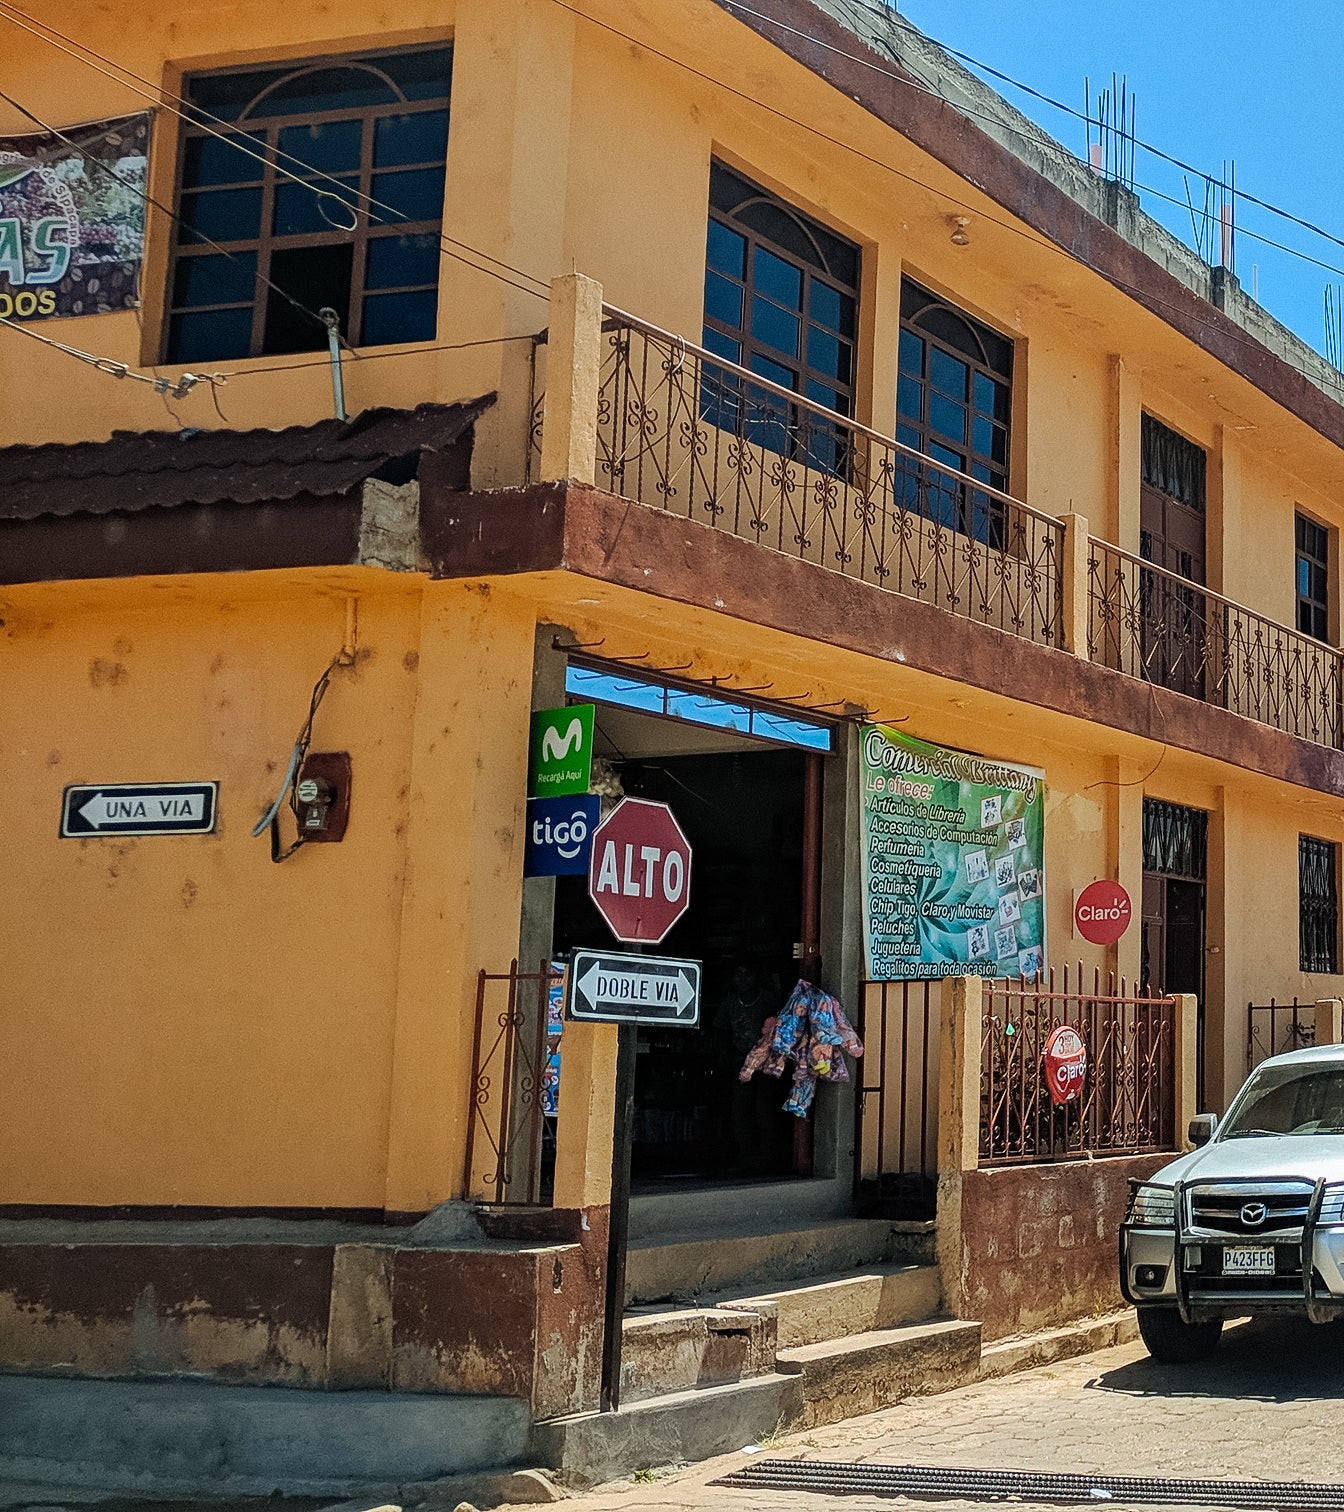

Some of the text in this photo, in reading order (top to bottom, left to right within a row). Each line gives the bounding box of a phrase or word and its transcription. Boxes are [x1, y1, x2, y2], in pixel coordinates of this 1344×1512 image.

[864, 728, 963, 782] Comercial
[566, 768, 582, 782] Aquí
[866, 769, 935, 800] Le ofrece:
[106, 799, 193, 818] UNA VIA
[870, 795, 966, 824] Artículos de Librería
[870, 815, 999, 847] Accesorios de Computación
[596, 840, 684, 903] ALTO
[870, 876, 917, 896] Celulares
[870, 896, 994, 921] Chip Tigo, Claro y Movistar
[1078, 900, 1124, 922] Claro
[870, 917, 916, 935] Peluches
[872, 957, 997, 979] Regalitos para toda ocasión
[596, 974, 679, 1002] DOBLE VIA
[1057, 1060, 1085, 1082] Claro
[1224, 1251, 1274, 1267] P423FFG
